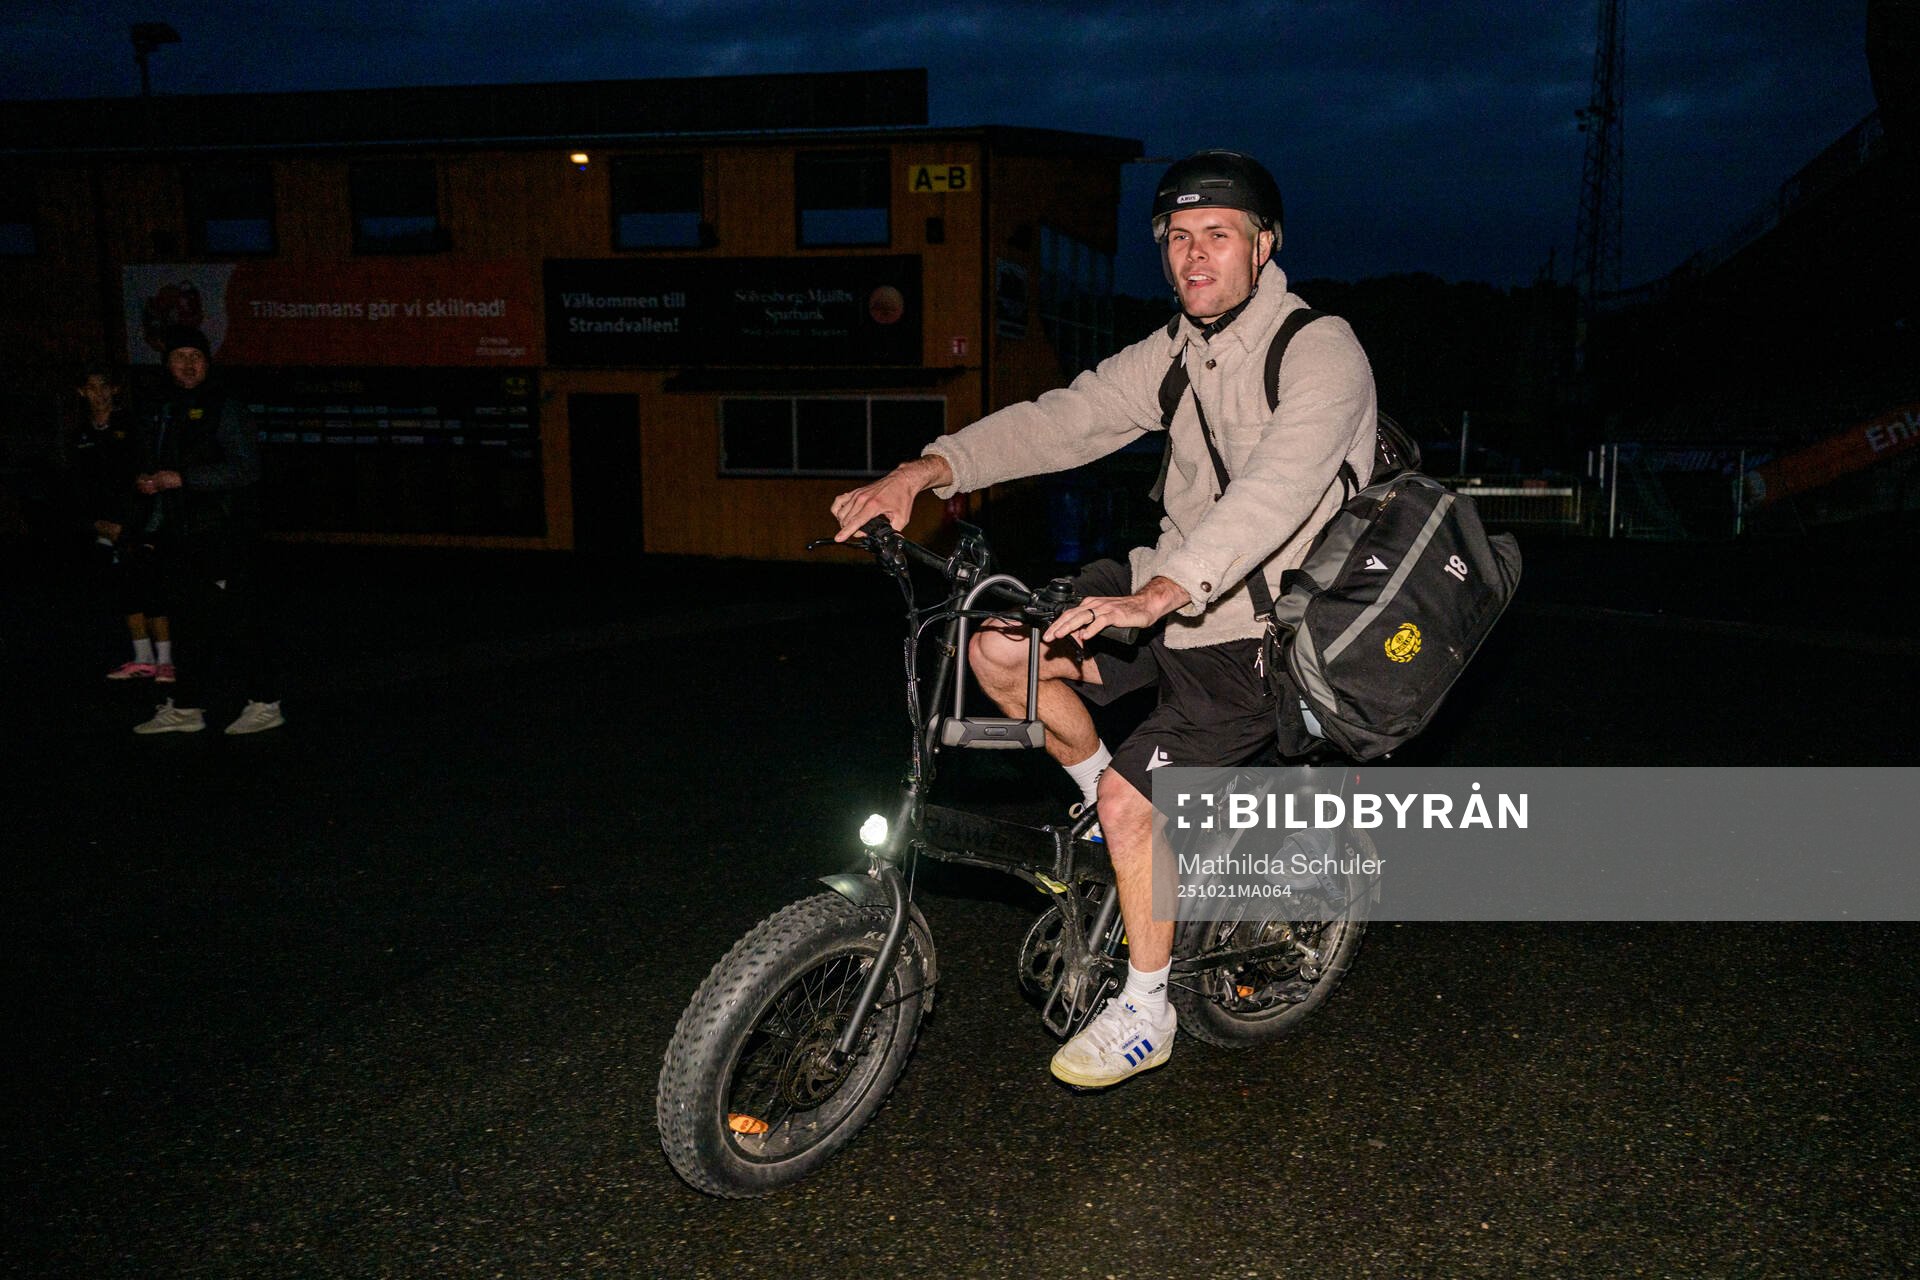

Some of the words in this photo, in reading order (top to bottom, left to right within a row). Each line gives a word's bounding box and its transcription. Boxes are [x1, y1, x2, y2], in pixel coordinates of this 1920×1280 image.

[915, 167, 966, 190] A-B
[249, 300, 363, 318] Tillsammans
[367, 299, 399, 320] gör
[404, 299, 421, 317] vi
[426, 298, 507, 318] skillnad!
[560, 290, 659, 309] Välkommen
[662, 290, 687, 309] till
[568, 316, 681, 334] Strandvallen!
[1443, 554, 1469, 582] 18
